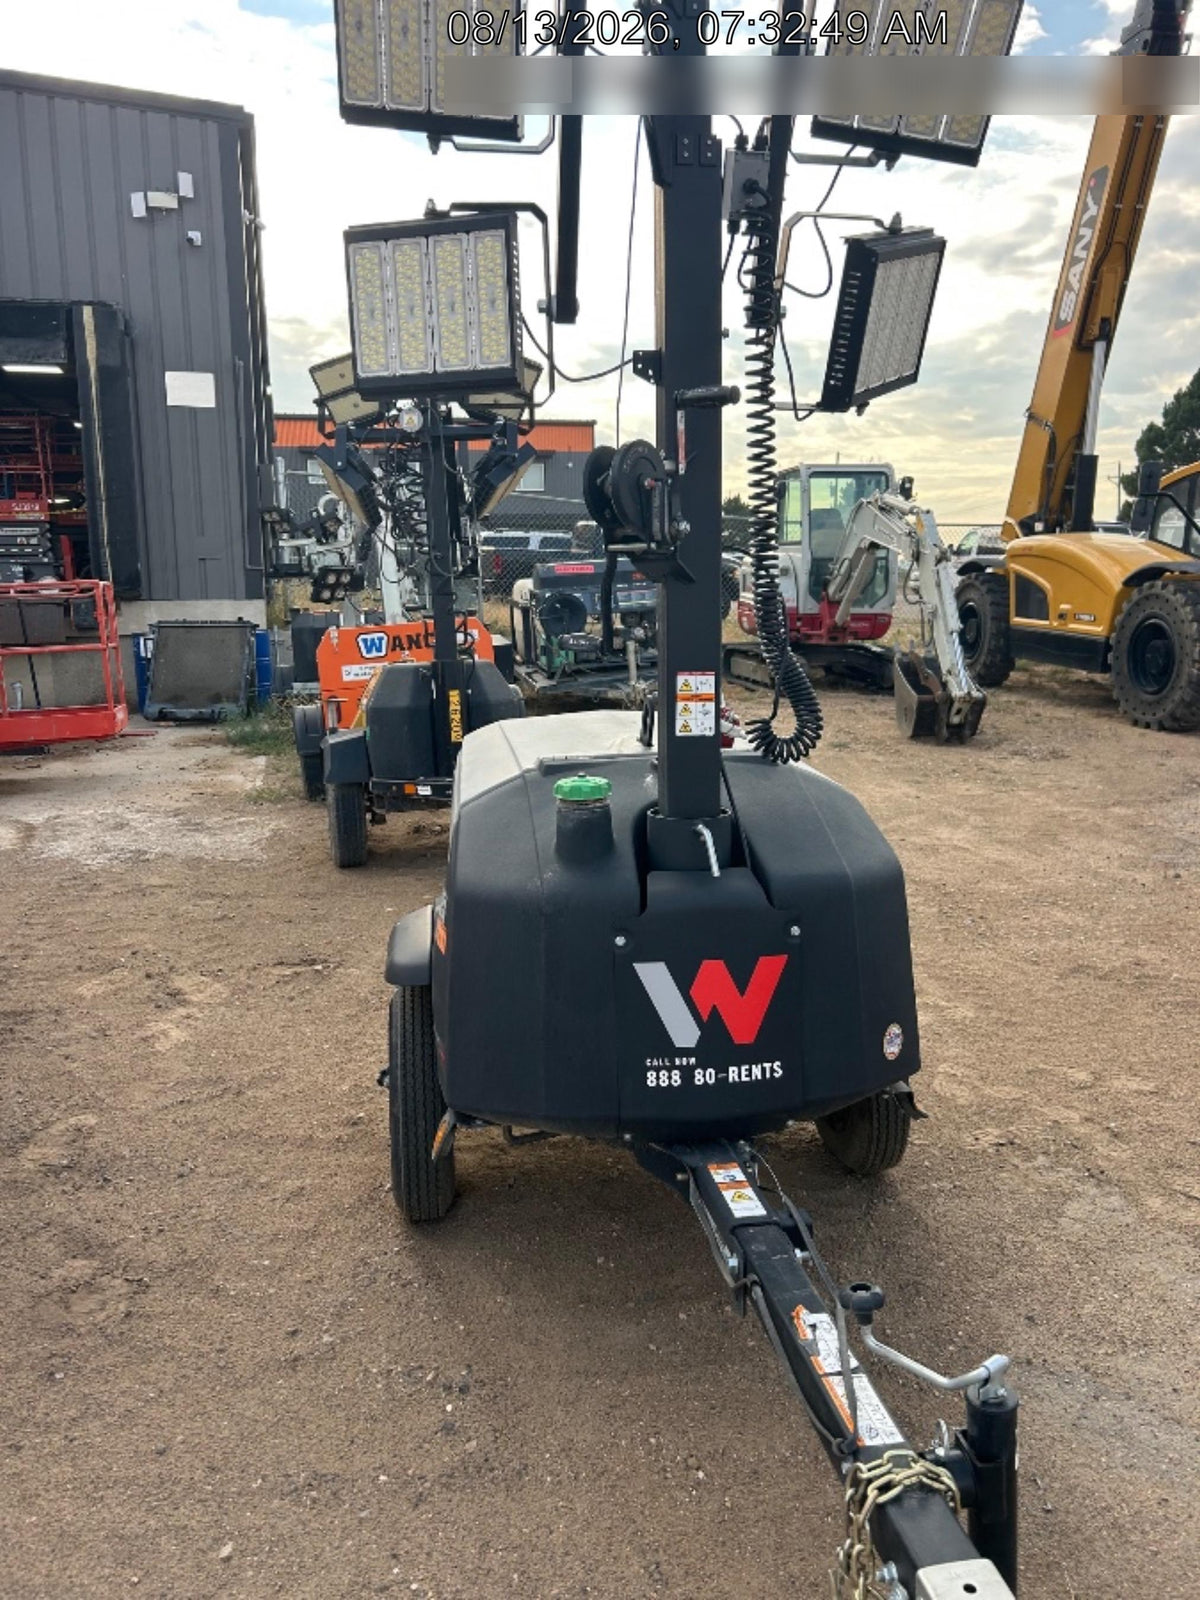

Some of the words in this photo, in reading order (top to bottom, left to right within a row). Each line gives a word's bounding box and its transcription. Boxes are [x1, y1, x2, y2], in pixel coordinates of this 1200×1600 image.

[1060, 189, 1099, 322] SANY
[645, 1057, 671, 1066] CALL
[674, 1057, 697, 1066] NOW
[646, 1069, 682, 1087] 888
[694, 1061, 783, 1086] 80-RENTS
